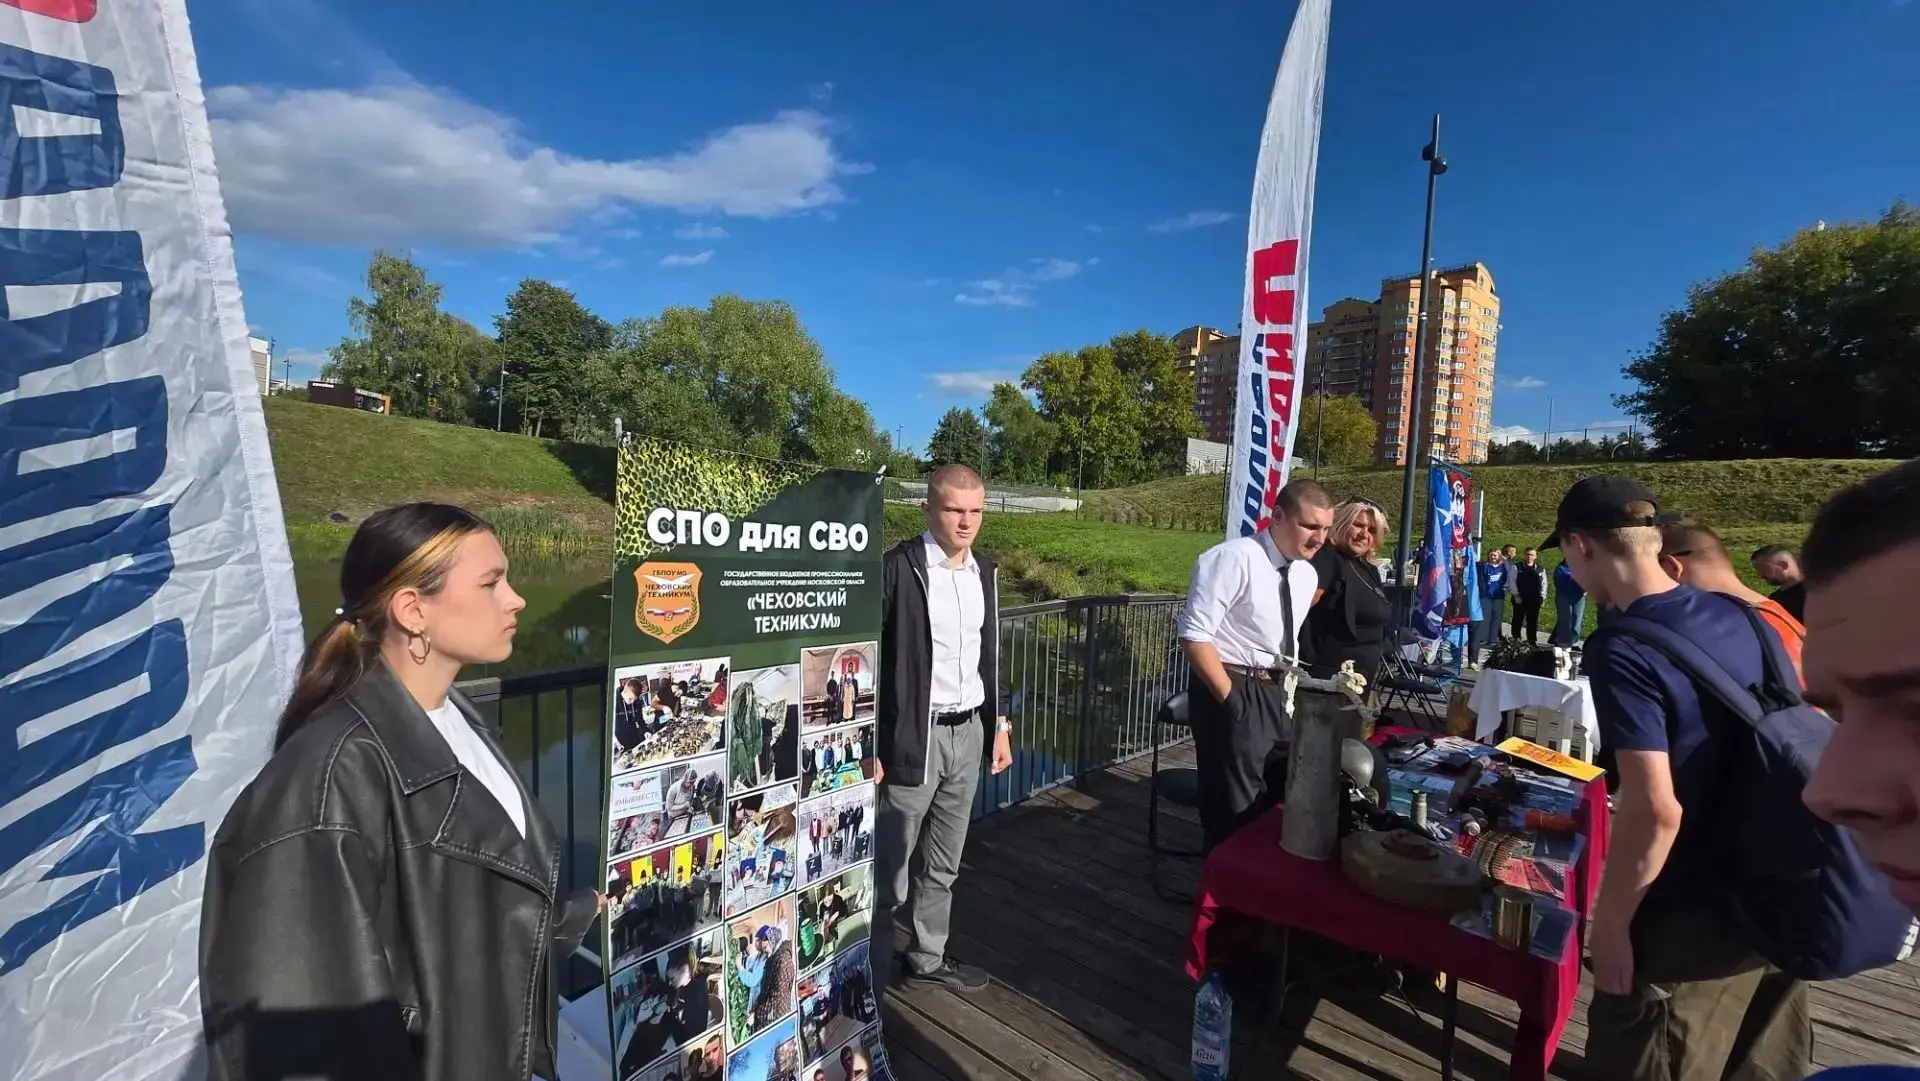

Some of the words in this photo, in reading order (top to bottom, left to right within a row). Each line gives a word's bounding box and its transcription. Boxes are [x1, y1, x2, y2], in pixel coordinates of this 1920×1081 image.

[646, 507, 731, 547] СПО
[738, 521, 801, 553] для
[808, 520, 869, 552] СВО
[747, 587, 848, 611] «ЧЕХОВСКИЙ
[754, 612, 841, 634] ТЕХНИКУМ»
